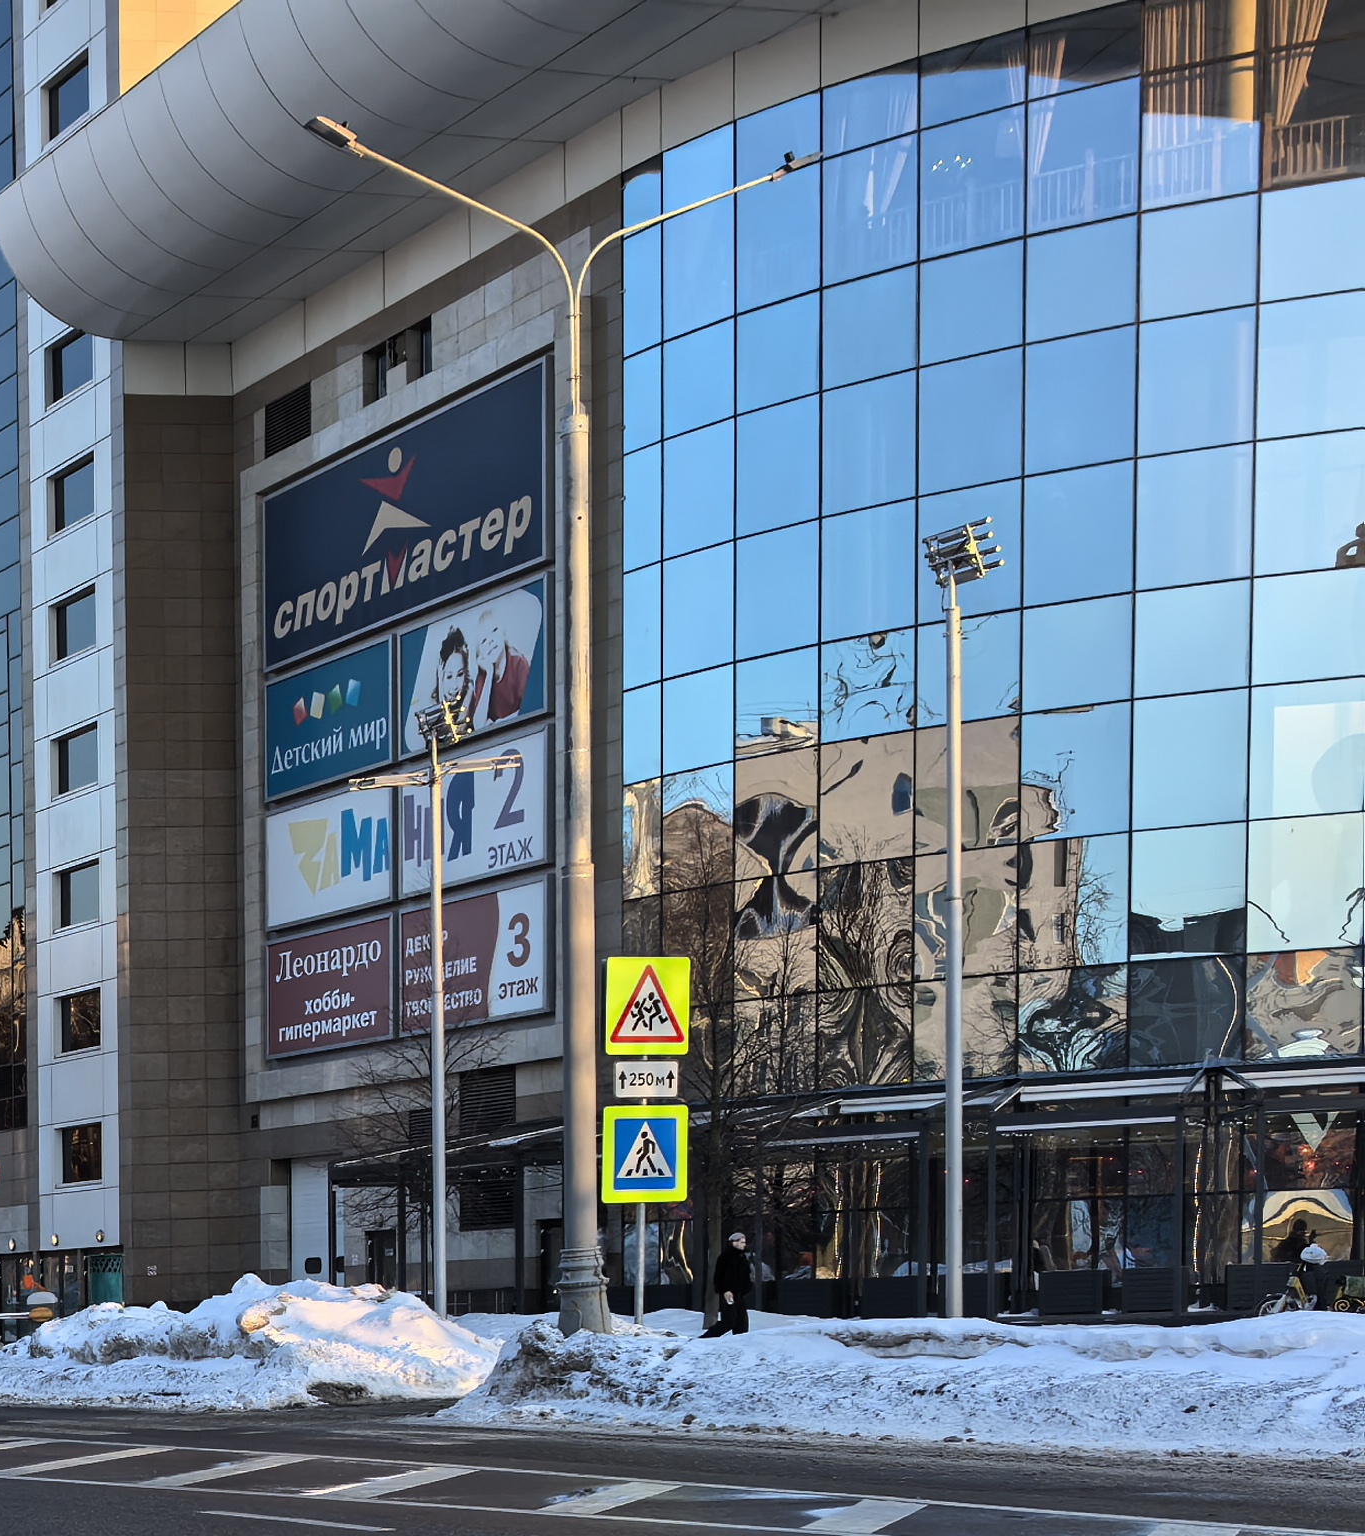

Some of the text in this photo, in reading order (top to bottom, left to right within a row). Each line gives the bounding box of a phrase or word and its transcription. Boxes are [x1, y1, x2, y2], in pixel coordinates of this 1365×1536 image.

[271, 716, 387, 776] Детский мир
[493, 748, 525, 831] 2
[487, 835, 533, 869] ЭТАЖ
[506, 912, 531, 968] 3
[275, 939, 382, 983] Леонардо
[304, 989, 355, 1016] хобби-
[498, 976, 539, 1000] этаж
[278, 1010, 377, 1042] гипермаркет
[629, 1072, 654, 1086] 250
